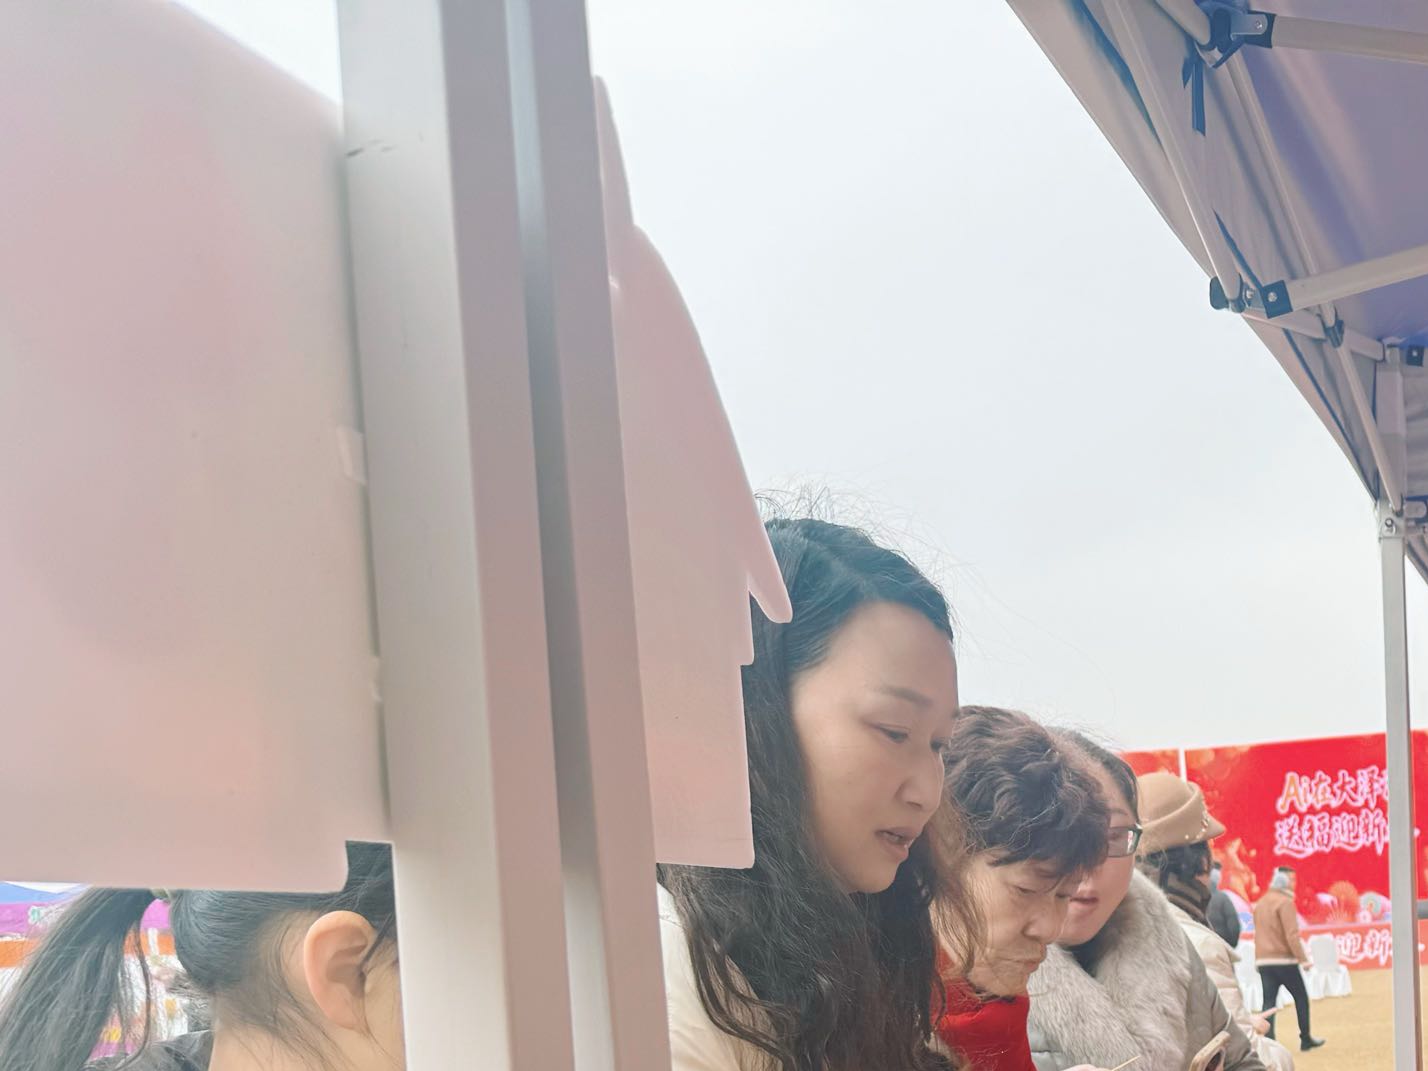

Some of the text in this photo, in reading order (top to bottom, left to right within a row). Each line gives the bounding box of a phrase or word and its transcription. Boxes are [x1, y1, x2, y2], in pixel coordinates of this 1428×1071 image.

[1276, 765, 1389, 814] Ai在大泽
[1274, 808, 1420, 858] 送福迎新
